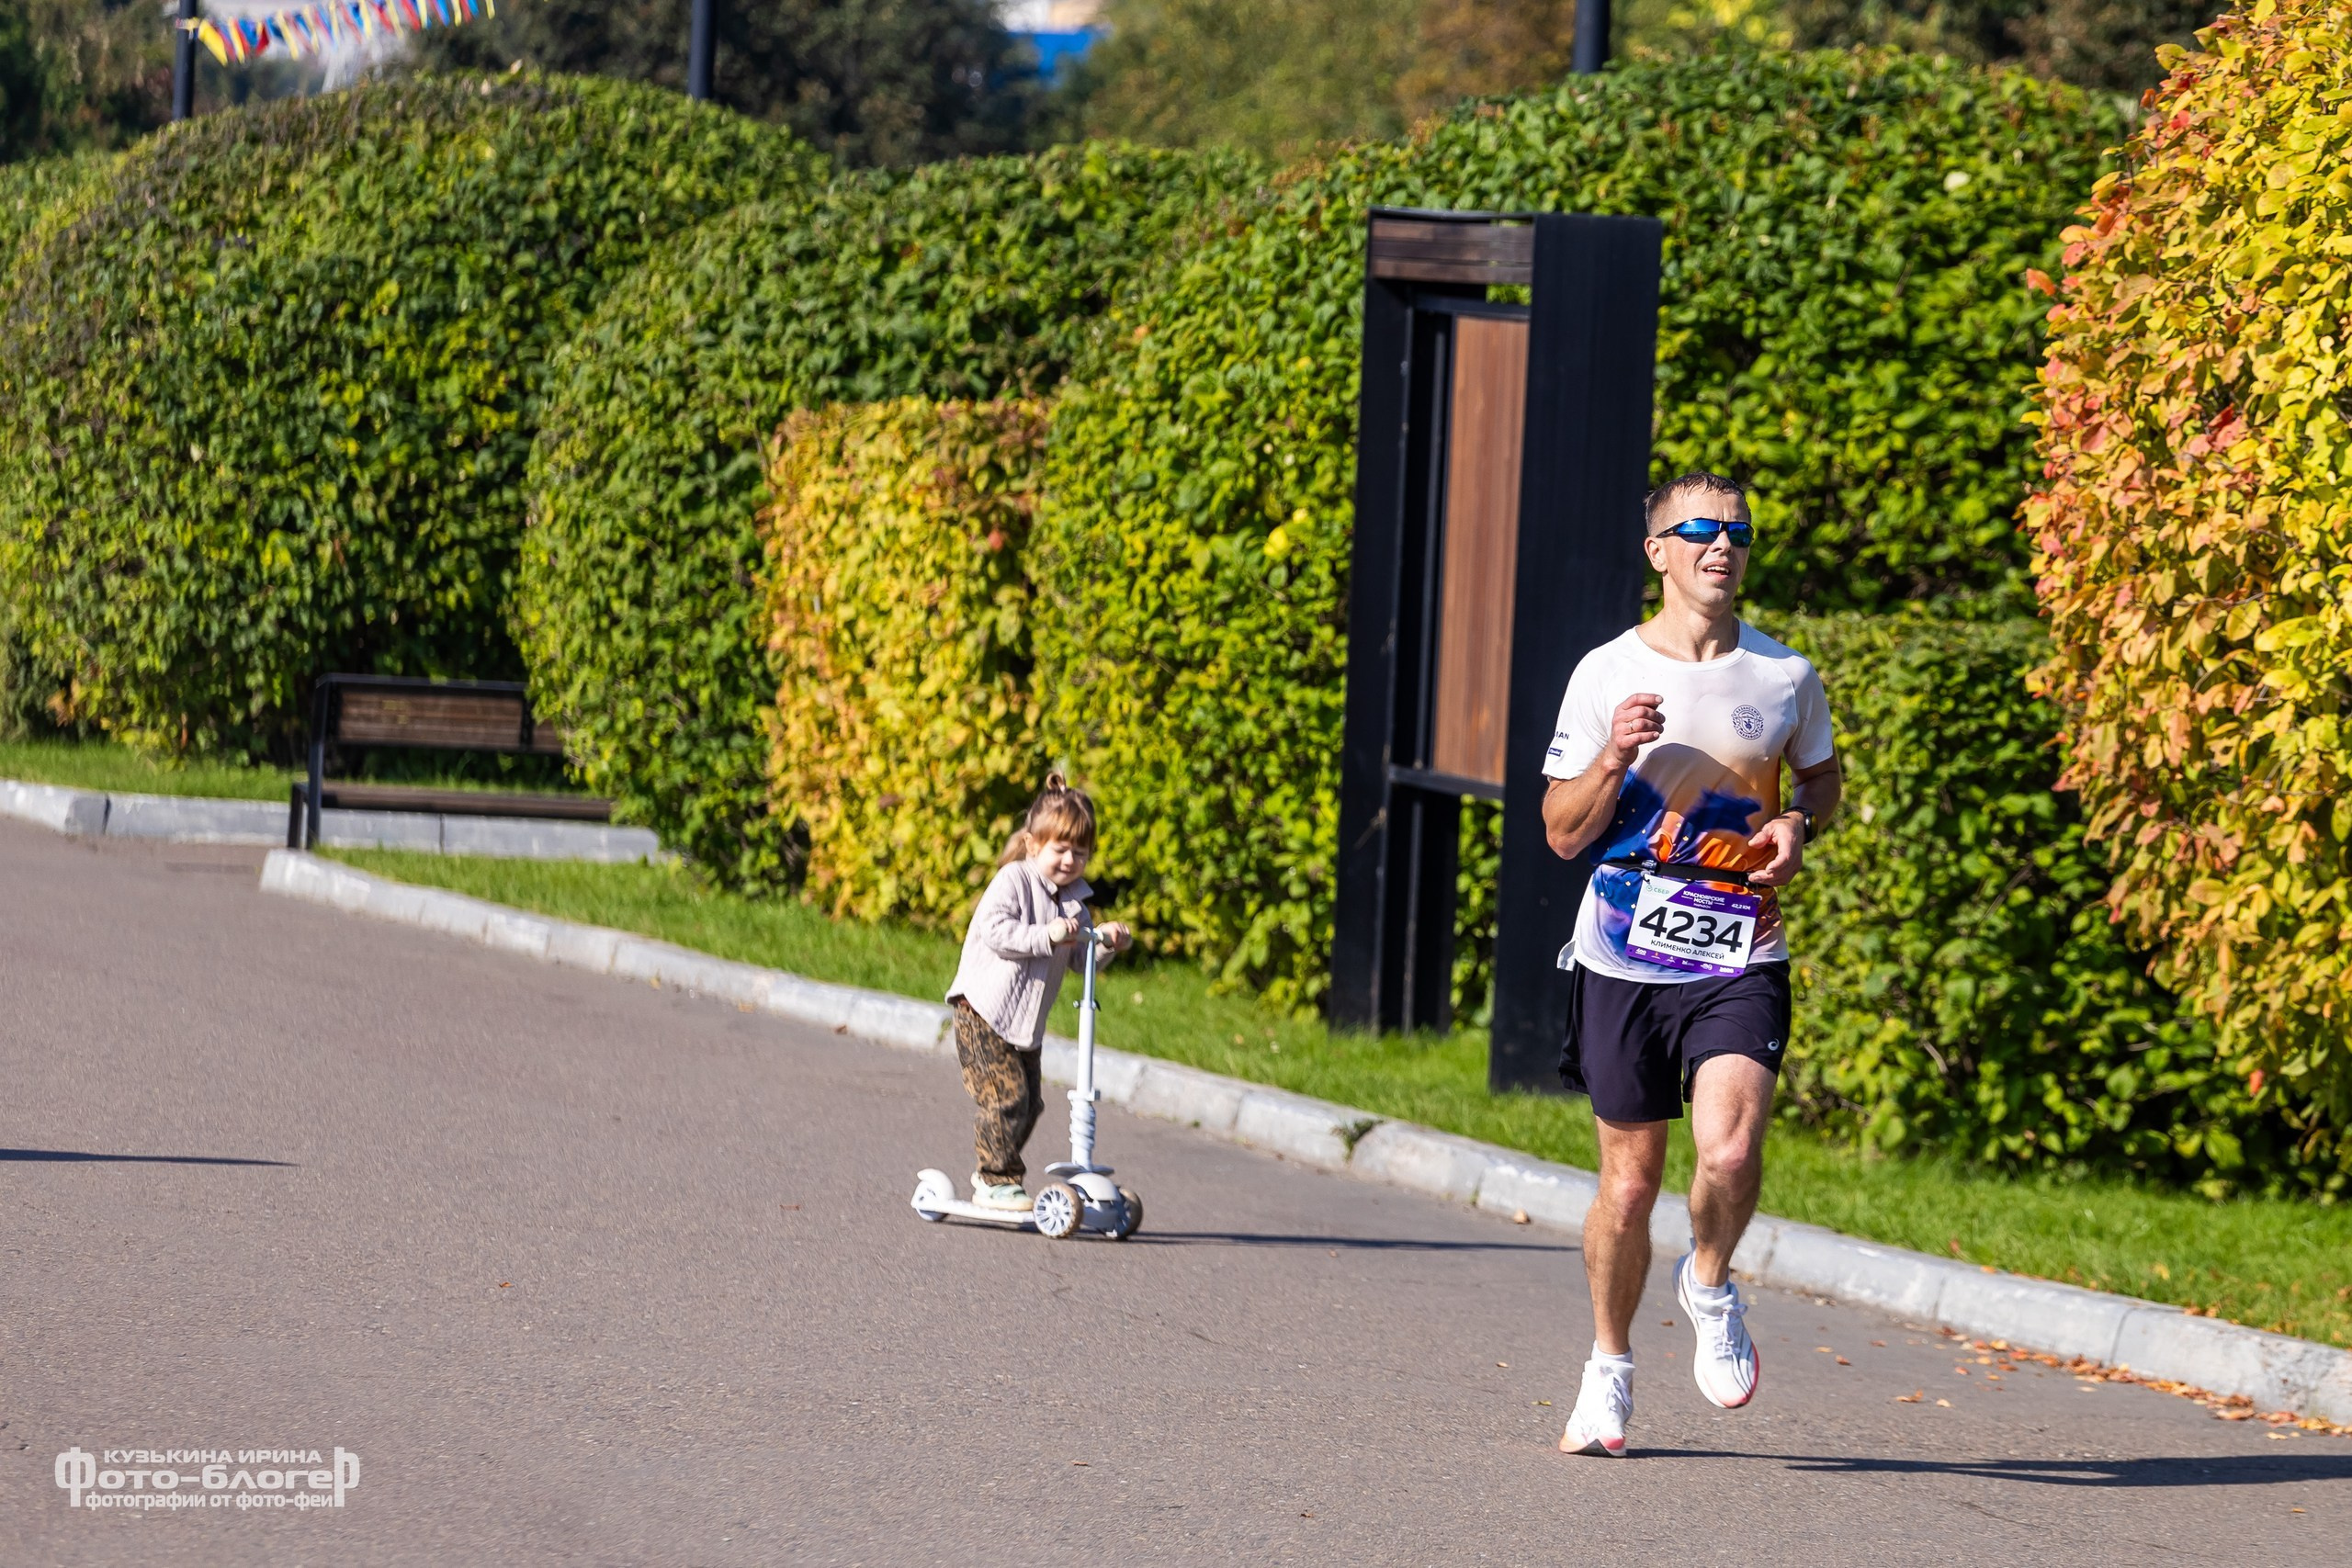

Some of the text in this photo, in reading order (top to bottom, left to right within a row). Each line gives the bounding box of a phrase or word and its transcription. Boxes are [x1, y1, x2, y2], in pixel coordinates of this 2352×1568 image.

[1639, 906, 1743, 953] 4234
[1650, 939, 1724, 960] КЛИМЕНКО АЛЕКСЕЙ
